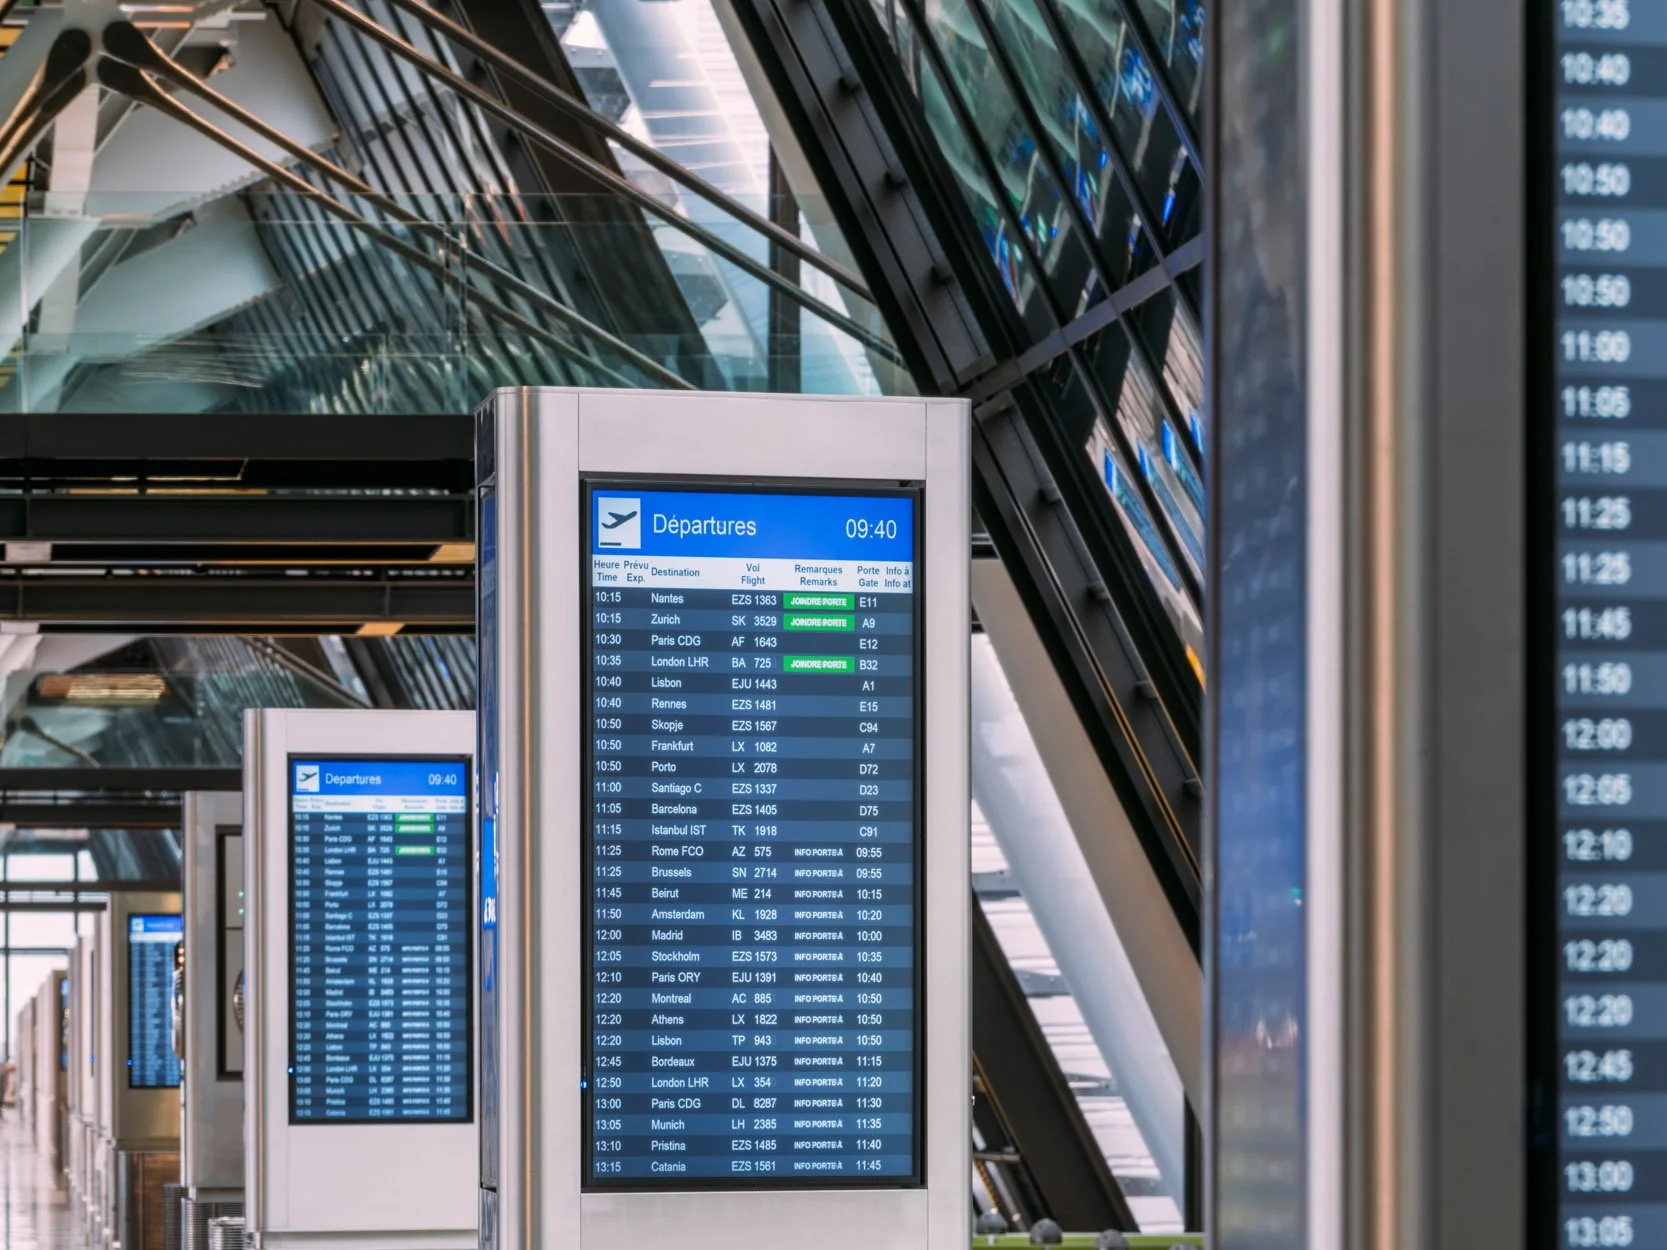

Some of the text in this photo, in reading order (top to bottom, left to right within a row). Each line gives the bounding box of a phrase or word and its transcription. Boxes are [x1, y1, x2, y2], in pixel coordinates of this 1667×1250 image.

[1561, 0, 1630, 29] 10:35
[1561, 53, 1631, 85] 10:40
[1561, 110, 1630, 140] 10:40
[1561, 164, 1631, 196] 10:50
[1561, 220, 1630, 251] 10:50
[1561, 274, 1631, 307] 10:50
[1561, 331, 1631, 362] 11:00
[1561, 386, 1631, 418] 11:05
[1561, 442, 1631, 473] 11:15
[1561, 497, 1632, 529] 11:25
[653, 513, 897, 542] Départures 09:40
[594, 560, 620, 570] Heure
[623, 560, 649, 570] Prévu
[745, 563, 760, 572] Vol
[794, 565, 843, 575] Remarques
[857, 566, 880, 575] Porte
[885, 566, 901, 576] Info
[651, 566, 700, 577] Destination
[1561, 552, 1631, 584] 11:25
[597, 573, 912, 589] Time Exp. Flight Remarks Gate Info at
[595, 591, 876, 608] 10:15 Nantes EZS 1363 E11
[595, 612, 875, 629] 10:15 Zurich SK 3529 A9
[1561, 607, 1632, 639] 11:45
[595, 633, 878, 650] 10:30 Paris CDG AF 1643 E12
[595, 654, 878, 671] 10:35 London LHR BA 725 B32
[595, 675, 874, 692] 10:40 Lisbon EJU 1443 A1
[1561, 663, 1632, 694] 11:50
[595, 696, 878, 713] 10:40 Rennes EZS 1481 E15
[595, 717, 878, 734] 10:50 Skopje EZS 1567 C94
[1563, 718, 1633, 749] 12:00
[595, 739, 875, 754] 10:50 Frankfurt A7
[595, 760, 878, 775] 10:50 Porto D72
[428, 774, 457, 785] 09:40
[595, 781, 621, 793] 11:00
[651, 782, 691, 796] Santiago
[859, 784, 878, 796] D23
[1563, 774, 1632, 804] 12:05
[595, 802, 878, 817] 11:05 Barcelona D75
[595, 823, 877, 838] 11:15 Istanbul IST C91
[595, 844, 882, 858] 11:25 Rome FCO 09:55
[1563, 829, 1633, 860] 12:10
[595, 865, 882, 879] 11:25 Brussels 09:55
[595, 886, 882, 900] 11:45 Beirut 10:15
[1563, 885, 1633, 915] 12:20
[595, 907, 882, 921] 11:50 Amsterdam 10:20
[595, 929, 882, 942] 12:00 Madrid 10:00
[595, 950, 882, 963] 12:05 Stockholm 10:35
[1563, 939, 1634, 971] 12:20
[595, 971, 882, 984] 12:10 Paris ORY 10:40
[595, 992, 882, 1004] 12:20 Montreal 10:50
[595, 1013, 882, 1025] 12:20 Athens 10:50
[1563, 995, 1633, 1026] 12:20
[595, 1034, 882, 1046] 12:20 Lisbon 10:50
[595, 1055, 882, 1068] 12:45 Bordeaux 11:15
[1563, 1050, 1634, 1081] 12:45
[595, 1076, 882, 1089] 12:50 London LHR 11:20
[595, 1096, 882, 1110] 13:00 Paris CDG 11:30
[595, 1117, 881, 1131] 13:05 Munich 11:35
[1563, 1106, 1634, 1136] 12:50
[595, 1138, 881, 1152] 13:10 Pristina 11:40
[595, 1159, 881, 1173] 13:15 Catania 11:45
[1563, 1161, 1634, 1191] 13:00
[1563, 1216, 1634, 1246] 13:05
